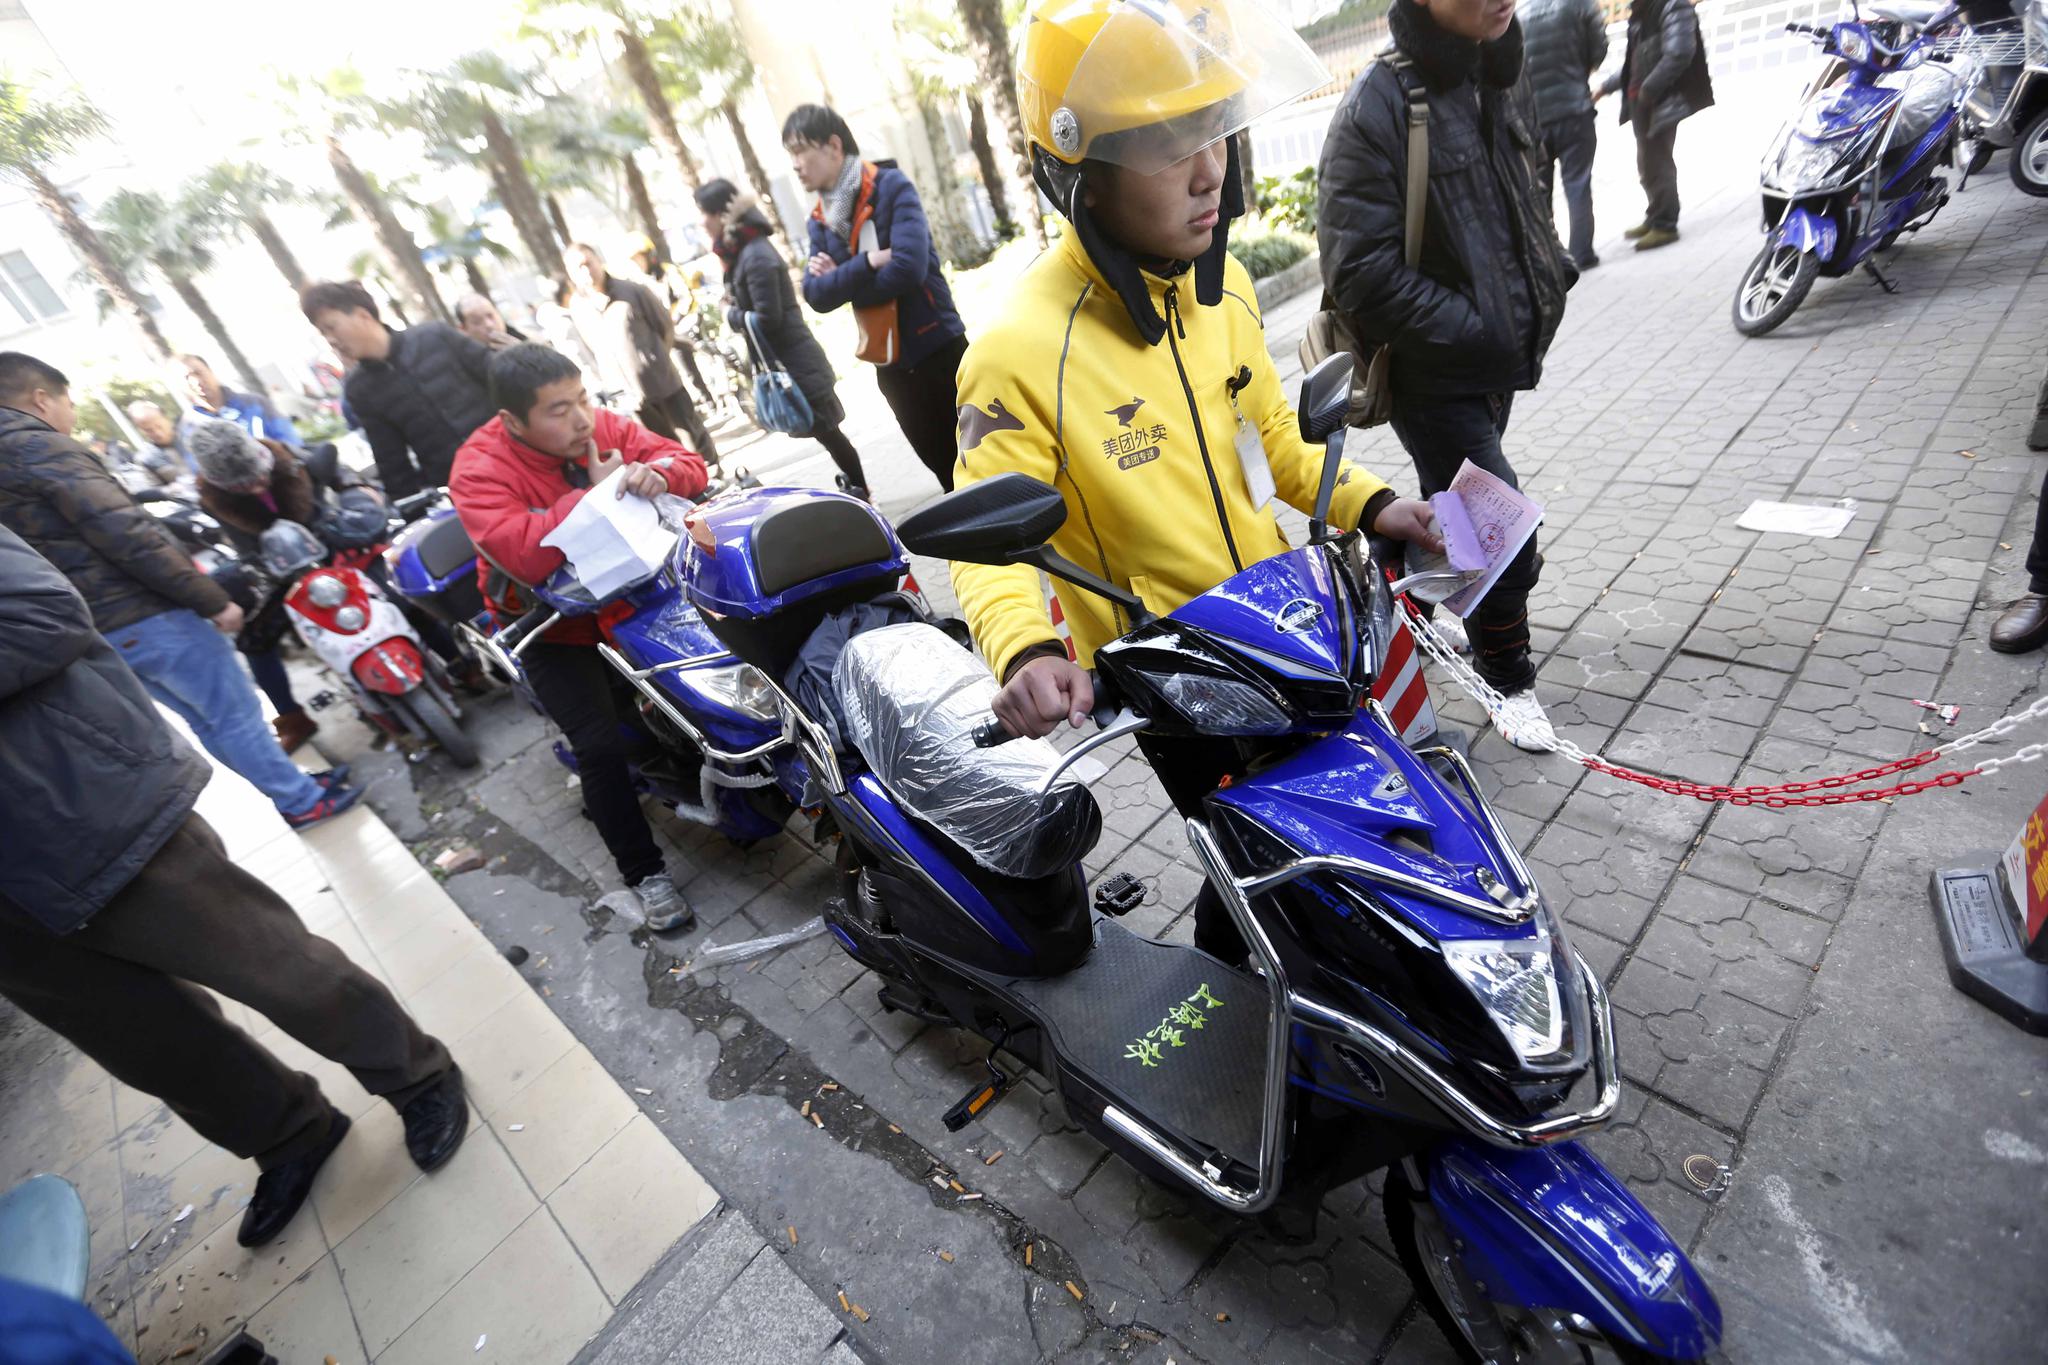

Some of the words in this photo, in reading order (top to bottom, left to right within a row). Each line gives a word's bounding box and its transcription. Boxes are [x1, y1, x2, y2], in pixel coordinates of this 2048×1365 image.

[1102, 423, 1168, 460] 美团外卖
[1122, 448, 1156, 469] 美团专送
